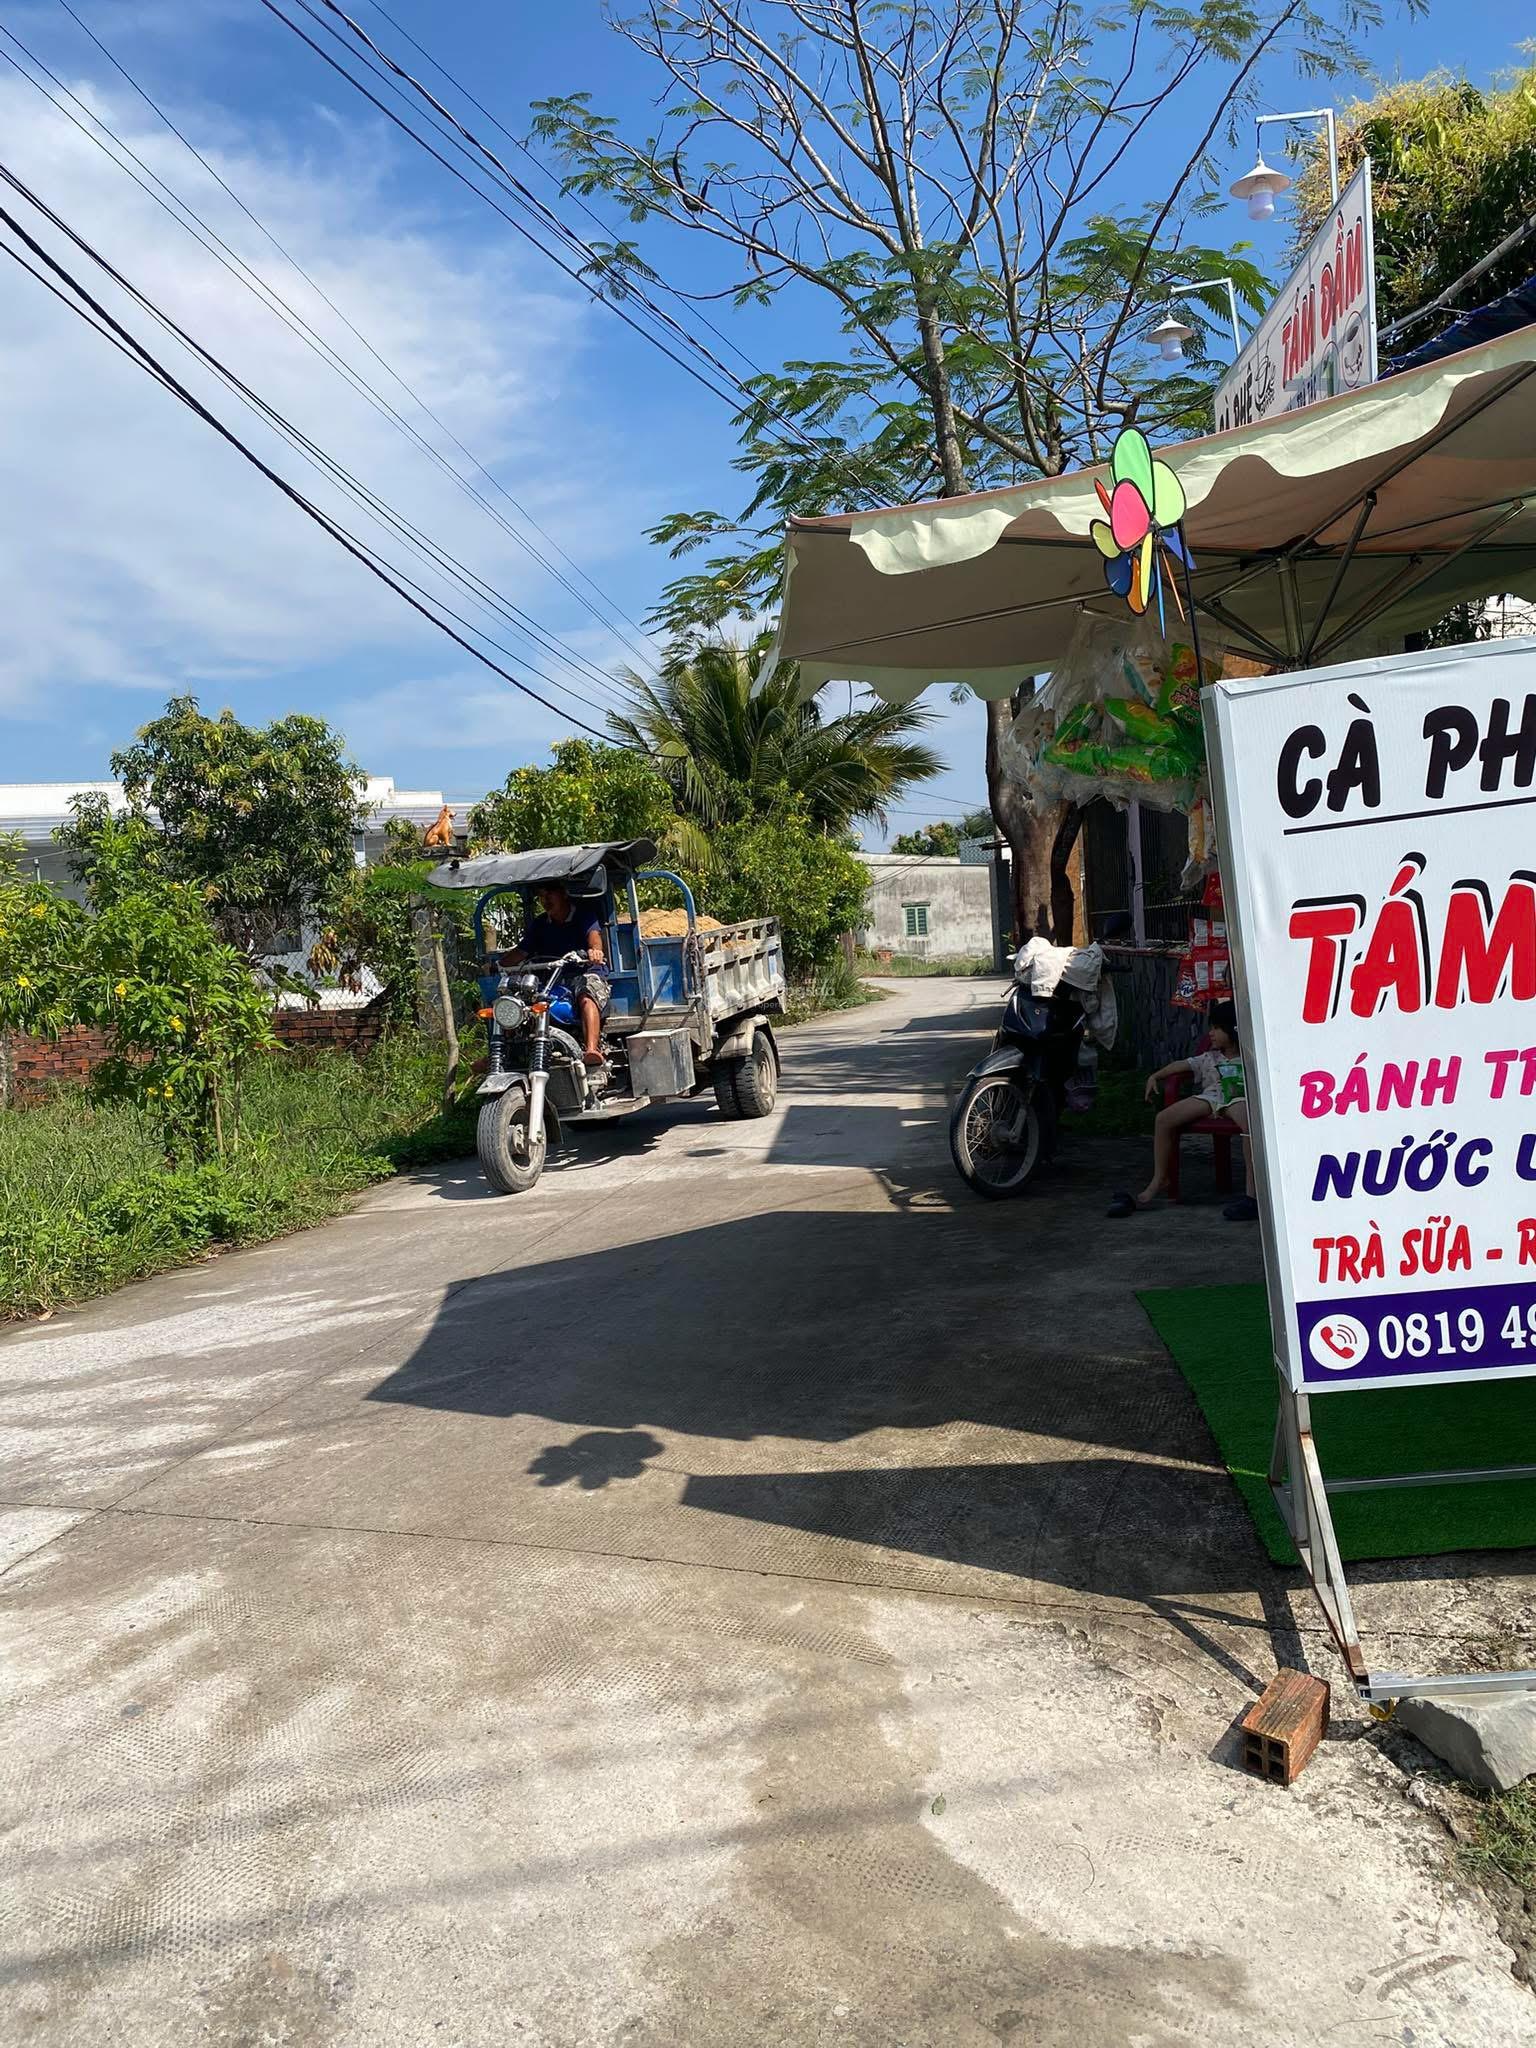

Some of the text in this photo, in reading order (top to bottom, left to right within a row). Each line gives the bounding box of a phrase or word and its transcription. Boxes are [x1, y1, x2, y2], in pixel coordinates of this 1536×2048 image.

[1282, 209, 1364, 389] TÁM ĐẦM
[1233, 362, 1252, 428] PHÊ
[1277, 692, 1536, 819] CÀ PH
[1288, 851, 1536, 1025] TÁM
[1299, 1053, 1462, 1119] BÁNH
[1311, 1129, 1493, 1202] NƯỚC
[1312, 1220, 1385, 1284] TRÀ
[1399, 1215, 1472, 1277] SỮA
[1378, 1308, 1485, 1360] 0819
